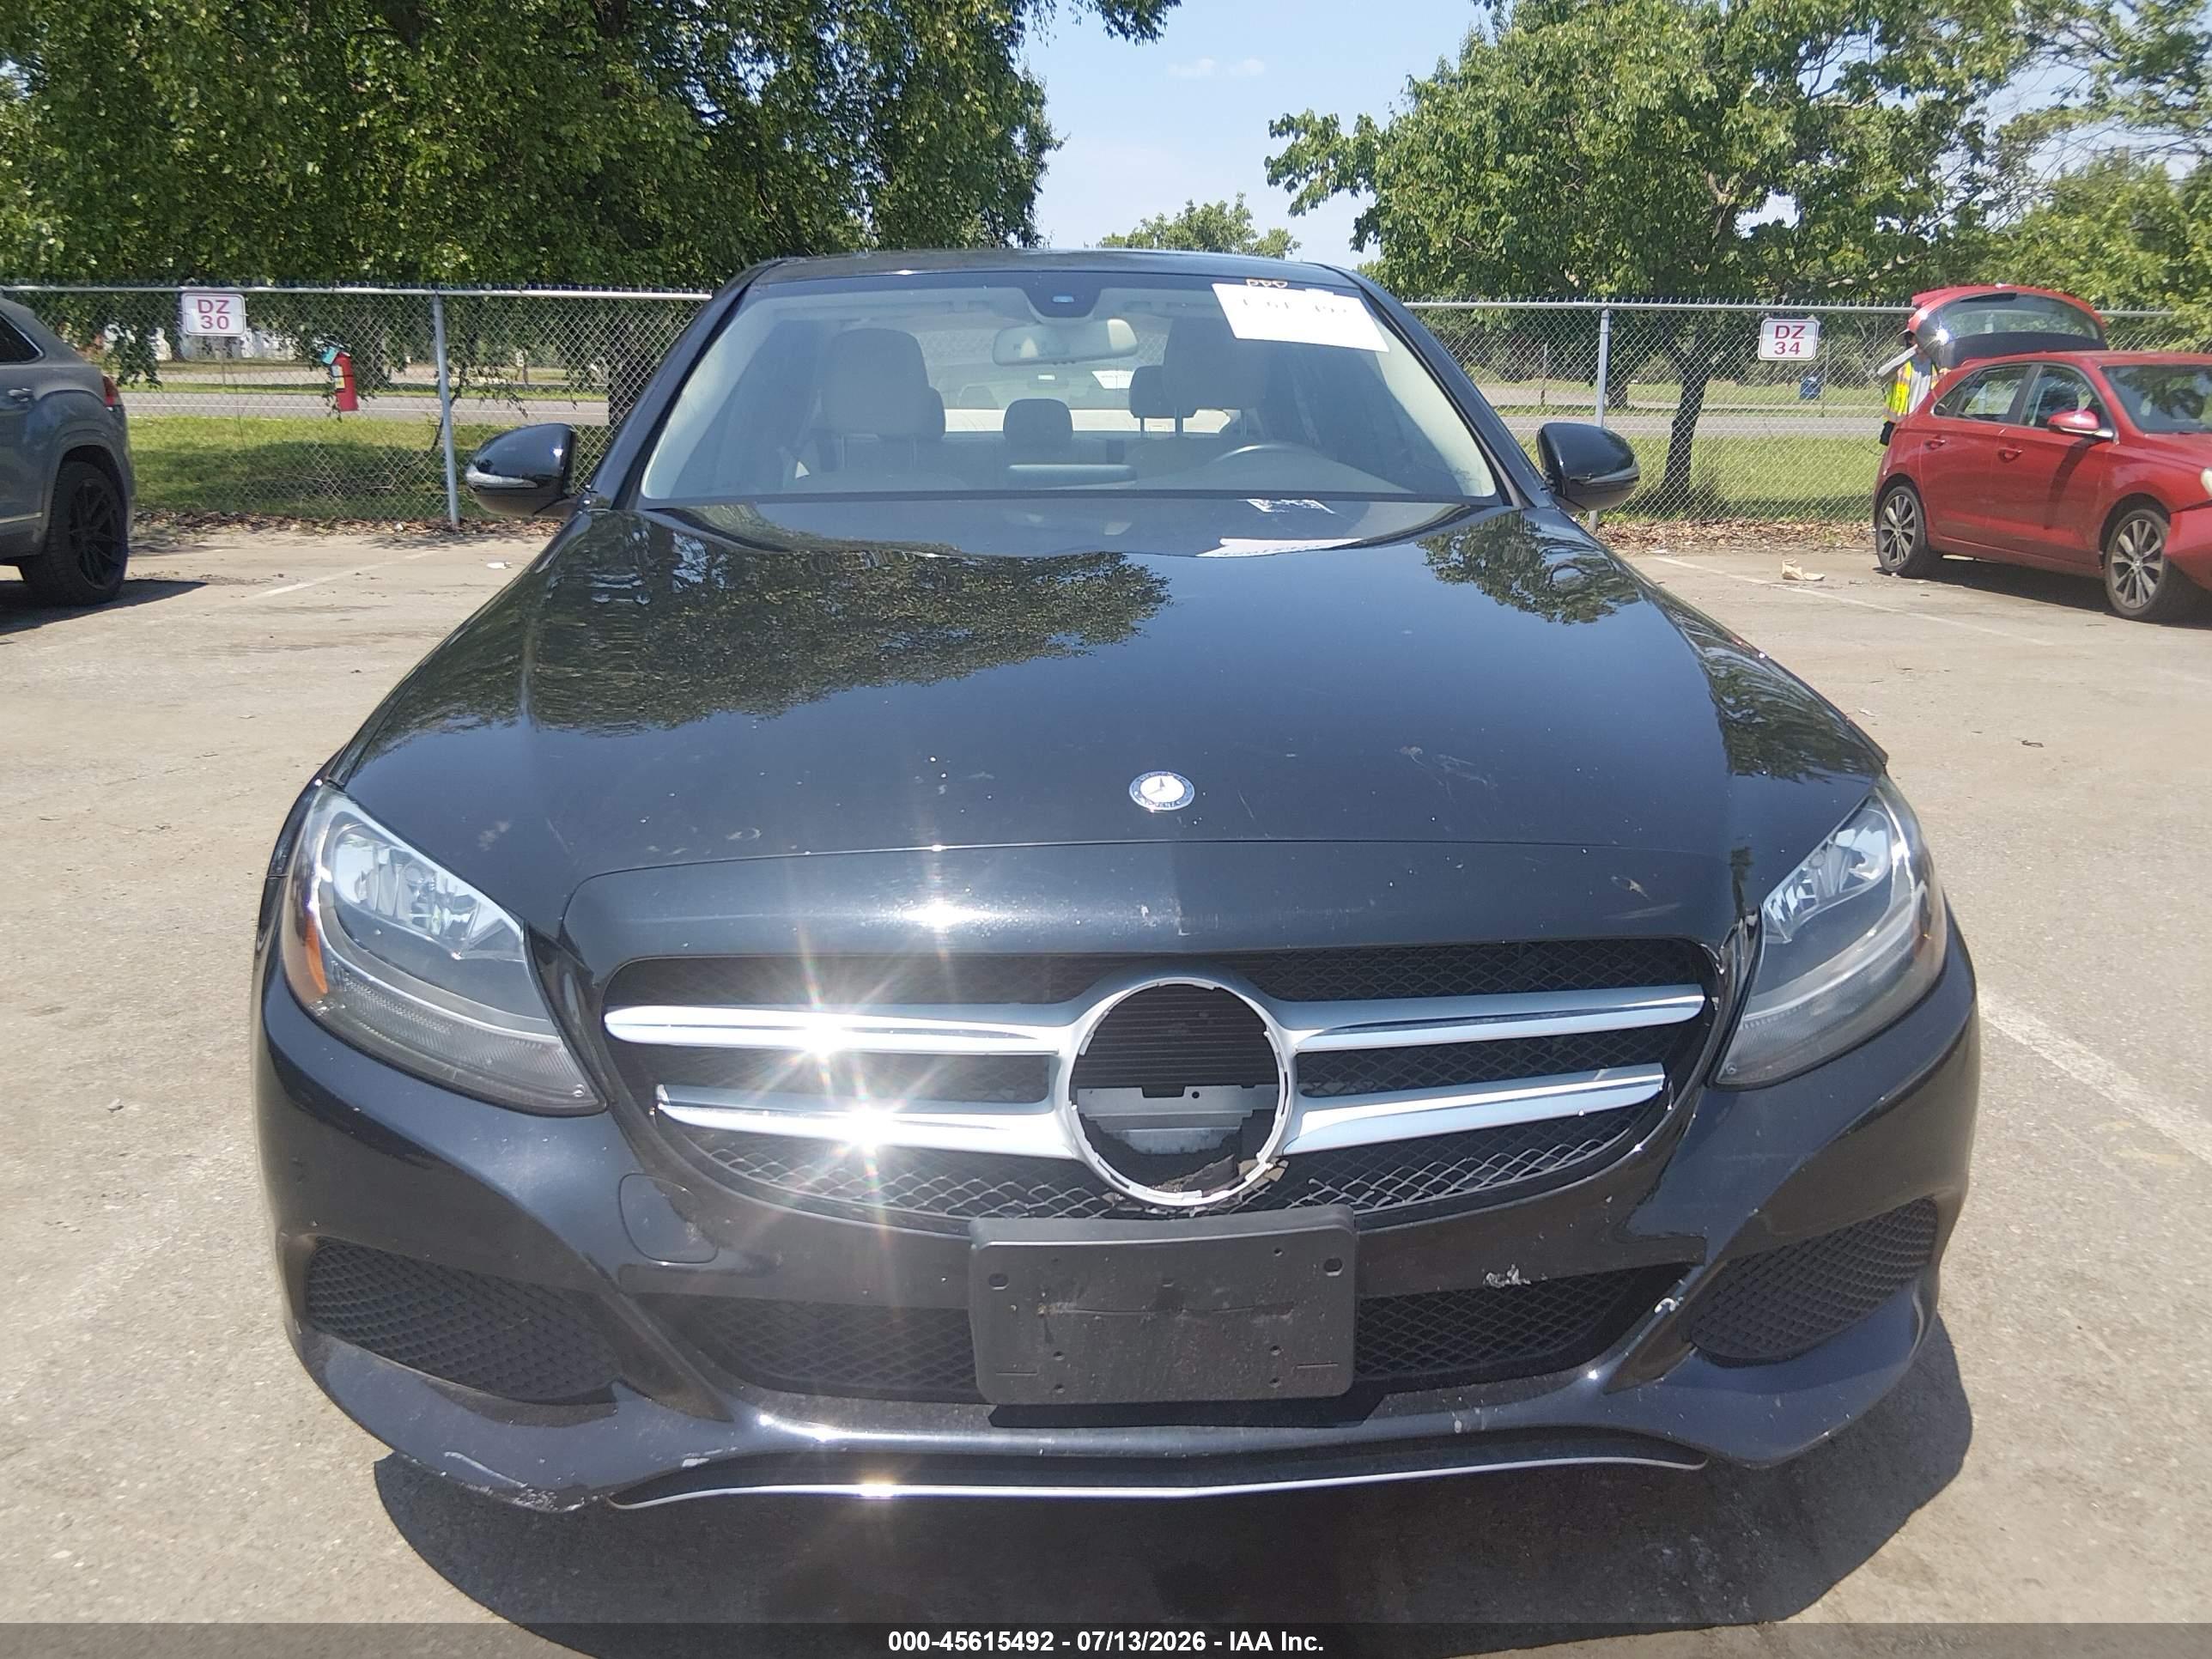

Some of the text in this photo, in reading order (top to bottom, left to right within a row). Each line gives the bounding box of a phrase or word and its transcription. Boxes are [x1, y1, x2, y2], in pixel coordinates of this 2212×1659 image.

[198, 299, 231, 314] DZ
[200, 314, 230, 330] 30
[1774, 325, 1806, 339] DZ
[1774, 341, 1801, 356] 34
